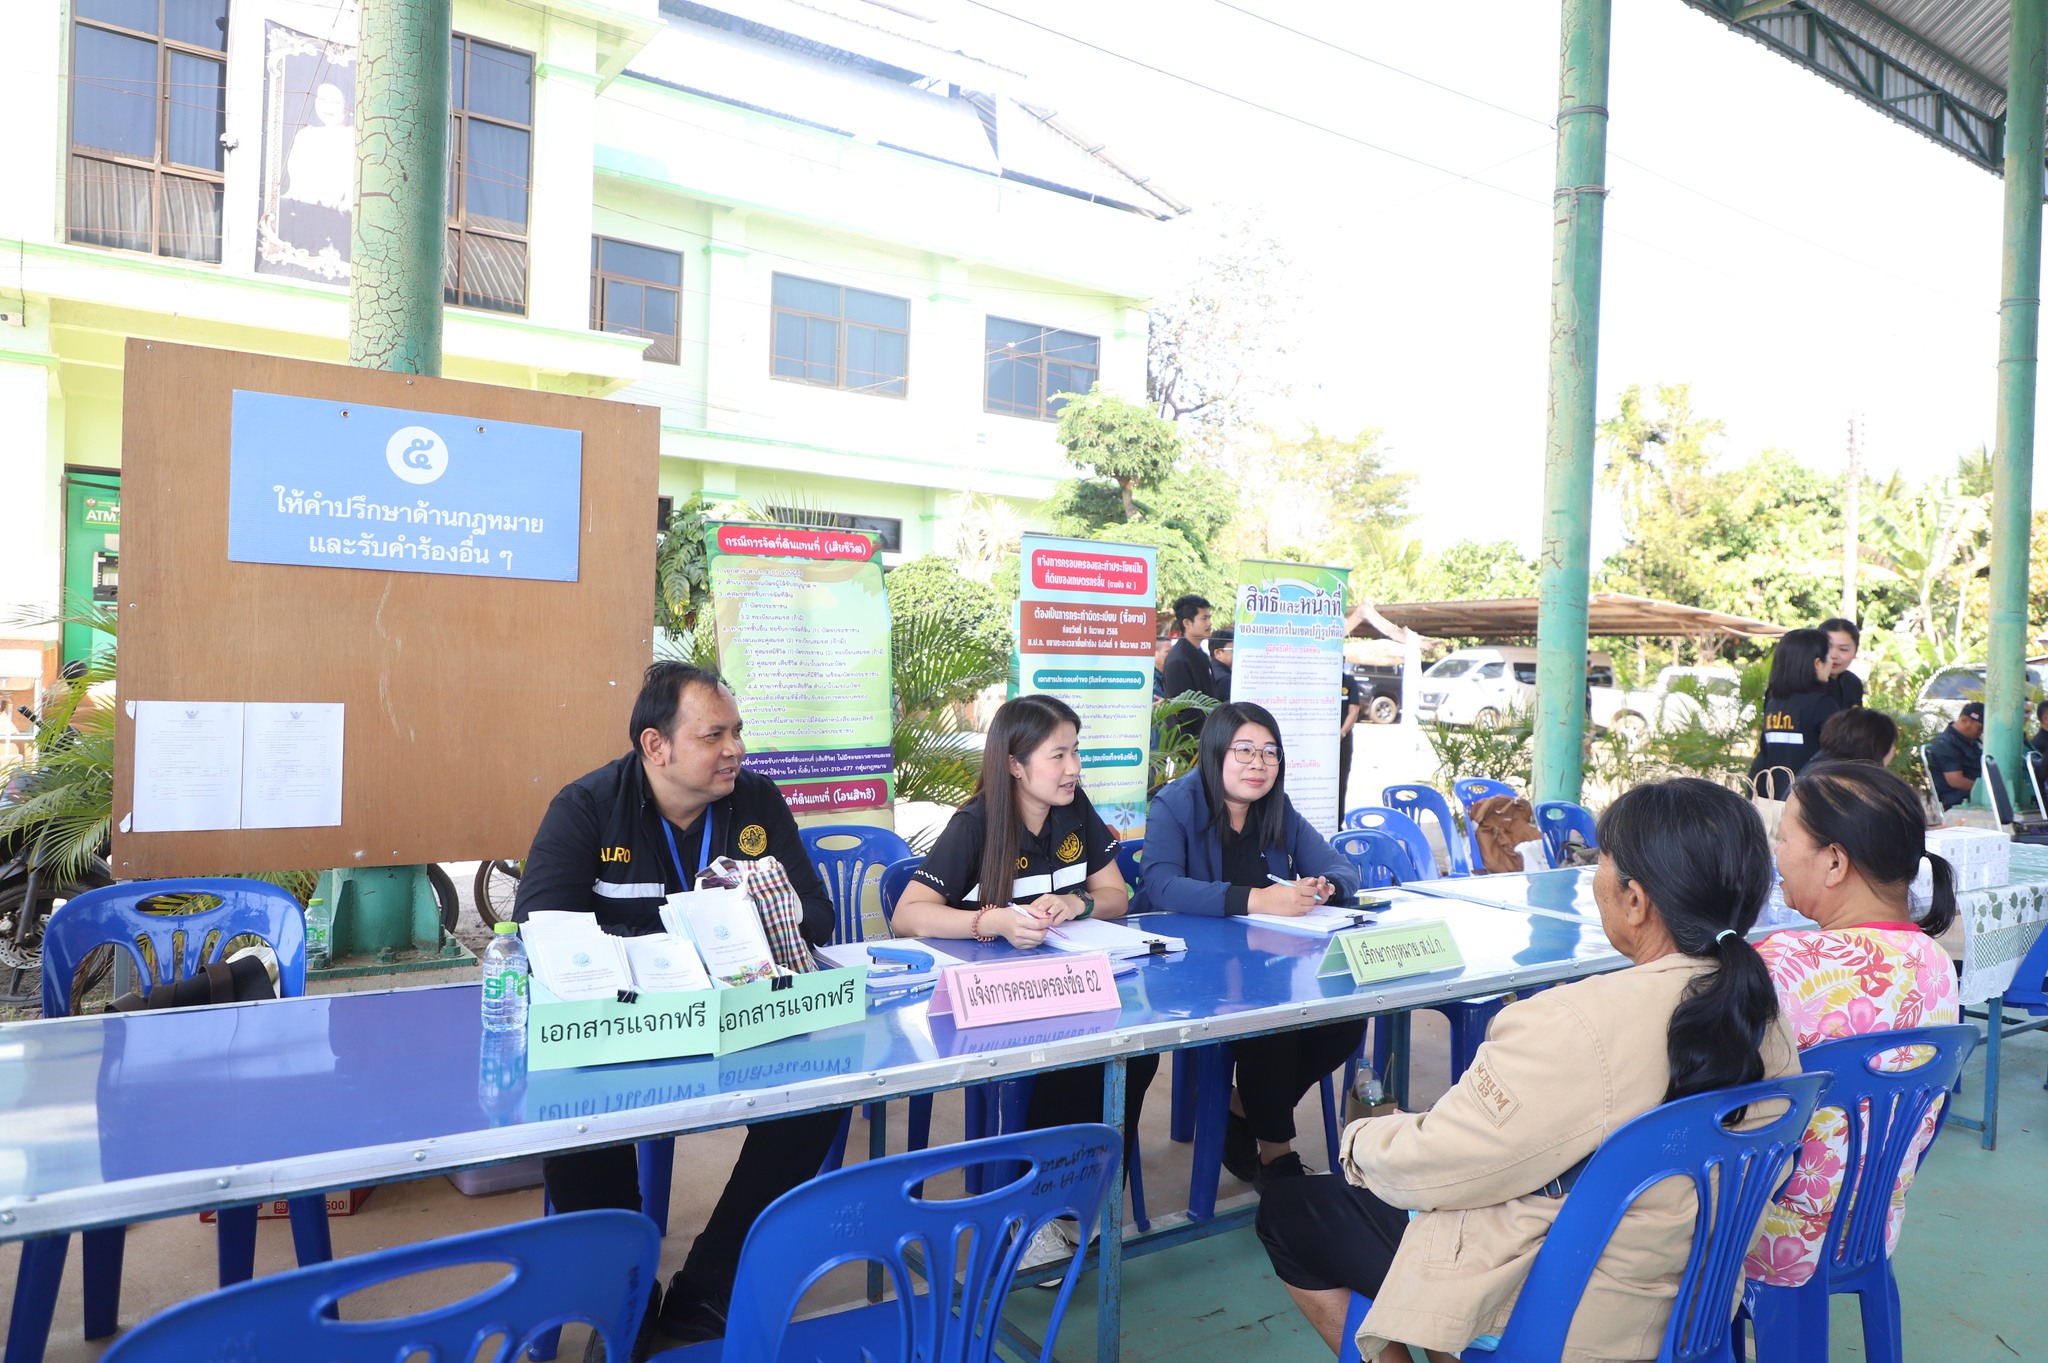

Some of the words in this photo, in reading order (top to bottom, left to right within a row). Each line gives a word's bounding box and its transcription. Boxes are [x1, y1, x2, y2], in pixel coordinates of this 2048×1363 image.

[402, 438, 434, 470] ๕
[86, 510, 117, 522] ATM
[273, 485, 544, 535] ให้คำปรึกษาด้านกฎหมาย
[309, 532, 490, 564] และรับคำร้องอื่น
[499, 548, 513, 570] ๆ
[725, 533, 820, 552] กรณีการจัดที่ดินแทนที่
[824, 540, 867, 555] (เสียชีวิต)
[1246, 583, 1342, 617] สิทธิและหน้าที่
[1120, 608, 1147, 625] (ซื้อขาย)
[1239, 621, 1344, 640] ของเกษตรกรในเขตปฏิรูปที่ดิน
[833, 787, 876, 804] (โอนสิทธิ)
[967, 964, 1085, 1007] แจ้งการครอบครองข้อ
[1085, 969, 1102, 993] 62
[719, 978, 855, 1032] เอกสารแจกฟรี
[540, 1000, 706, 1044] เอกสารแจกฟรี
[1474, 1061, 1511, 1112] SCRUM
[1478, 1082, 1490, 1098] 03
[276, 1202, 286, 1210] 80
[326, 1200, 345, 1211] 500
